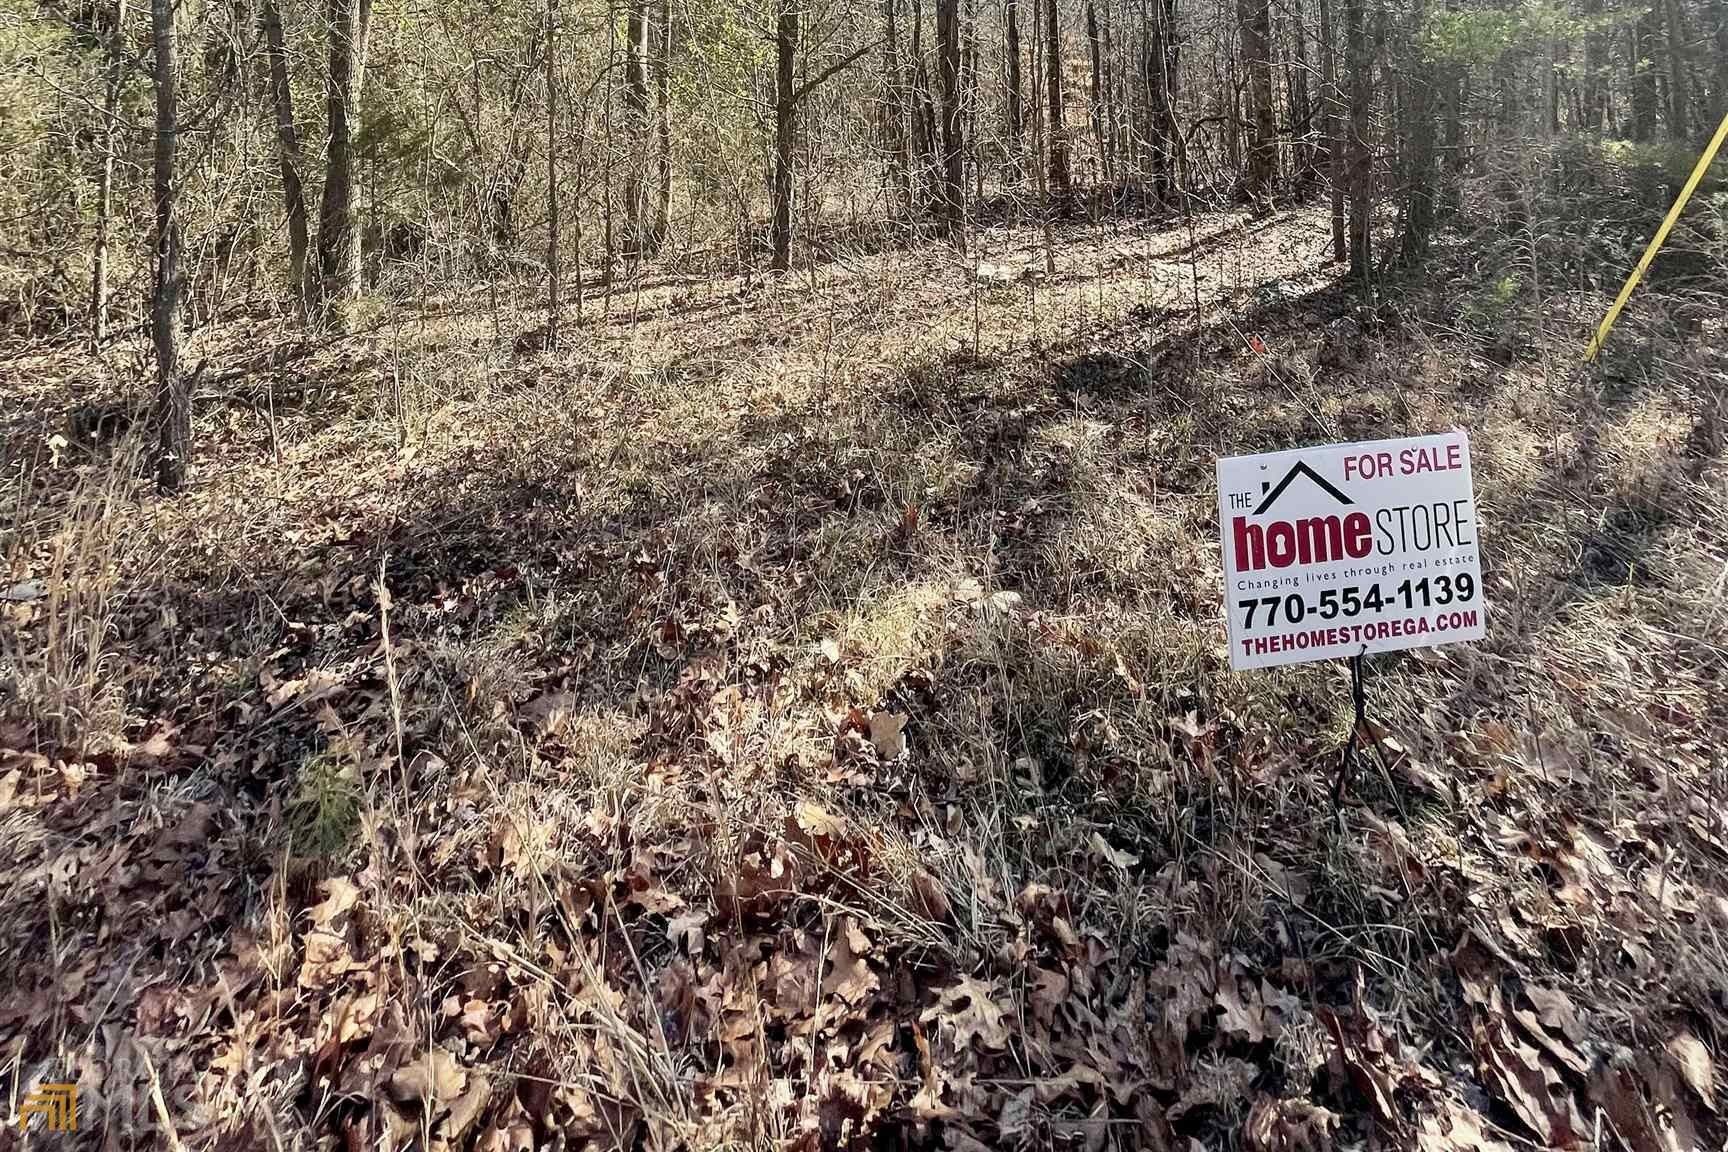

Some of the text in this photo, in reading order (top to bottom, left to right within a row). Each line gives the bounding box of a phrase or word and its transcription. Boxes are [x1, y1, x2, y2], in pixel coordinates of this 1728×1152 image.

[1343, 444, 1462, 481] FOR SALE
[1228, 491, 1253, 510] THE
[1232, 499, 1472, 572] home STORE
[1237, 553, 1474, 591] Changing lives through real estate
[1238, 572, 1475, 630] 770-554-1139
[1241, 610, 1478, 657] THEHOMESTOREGA.COM
